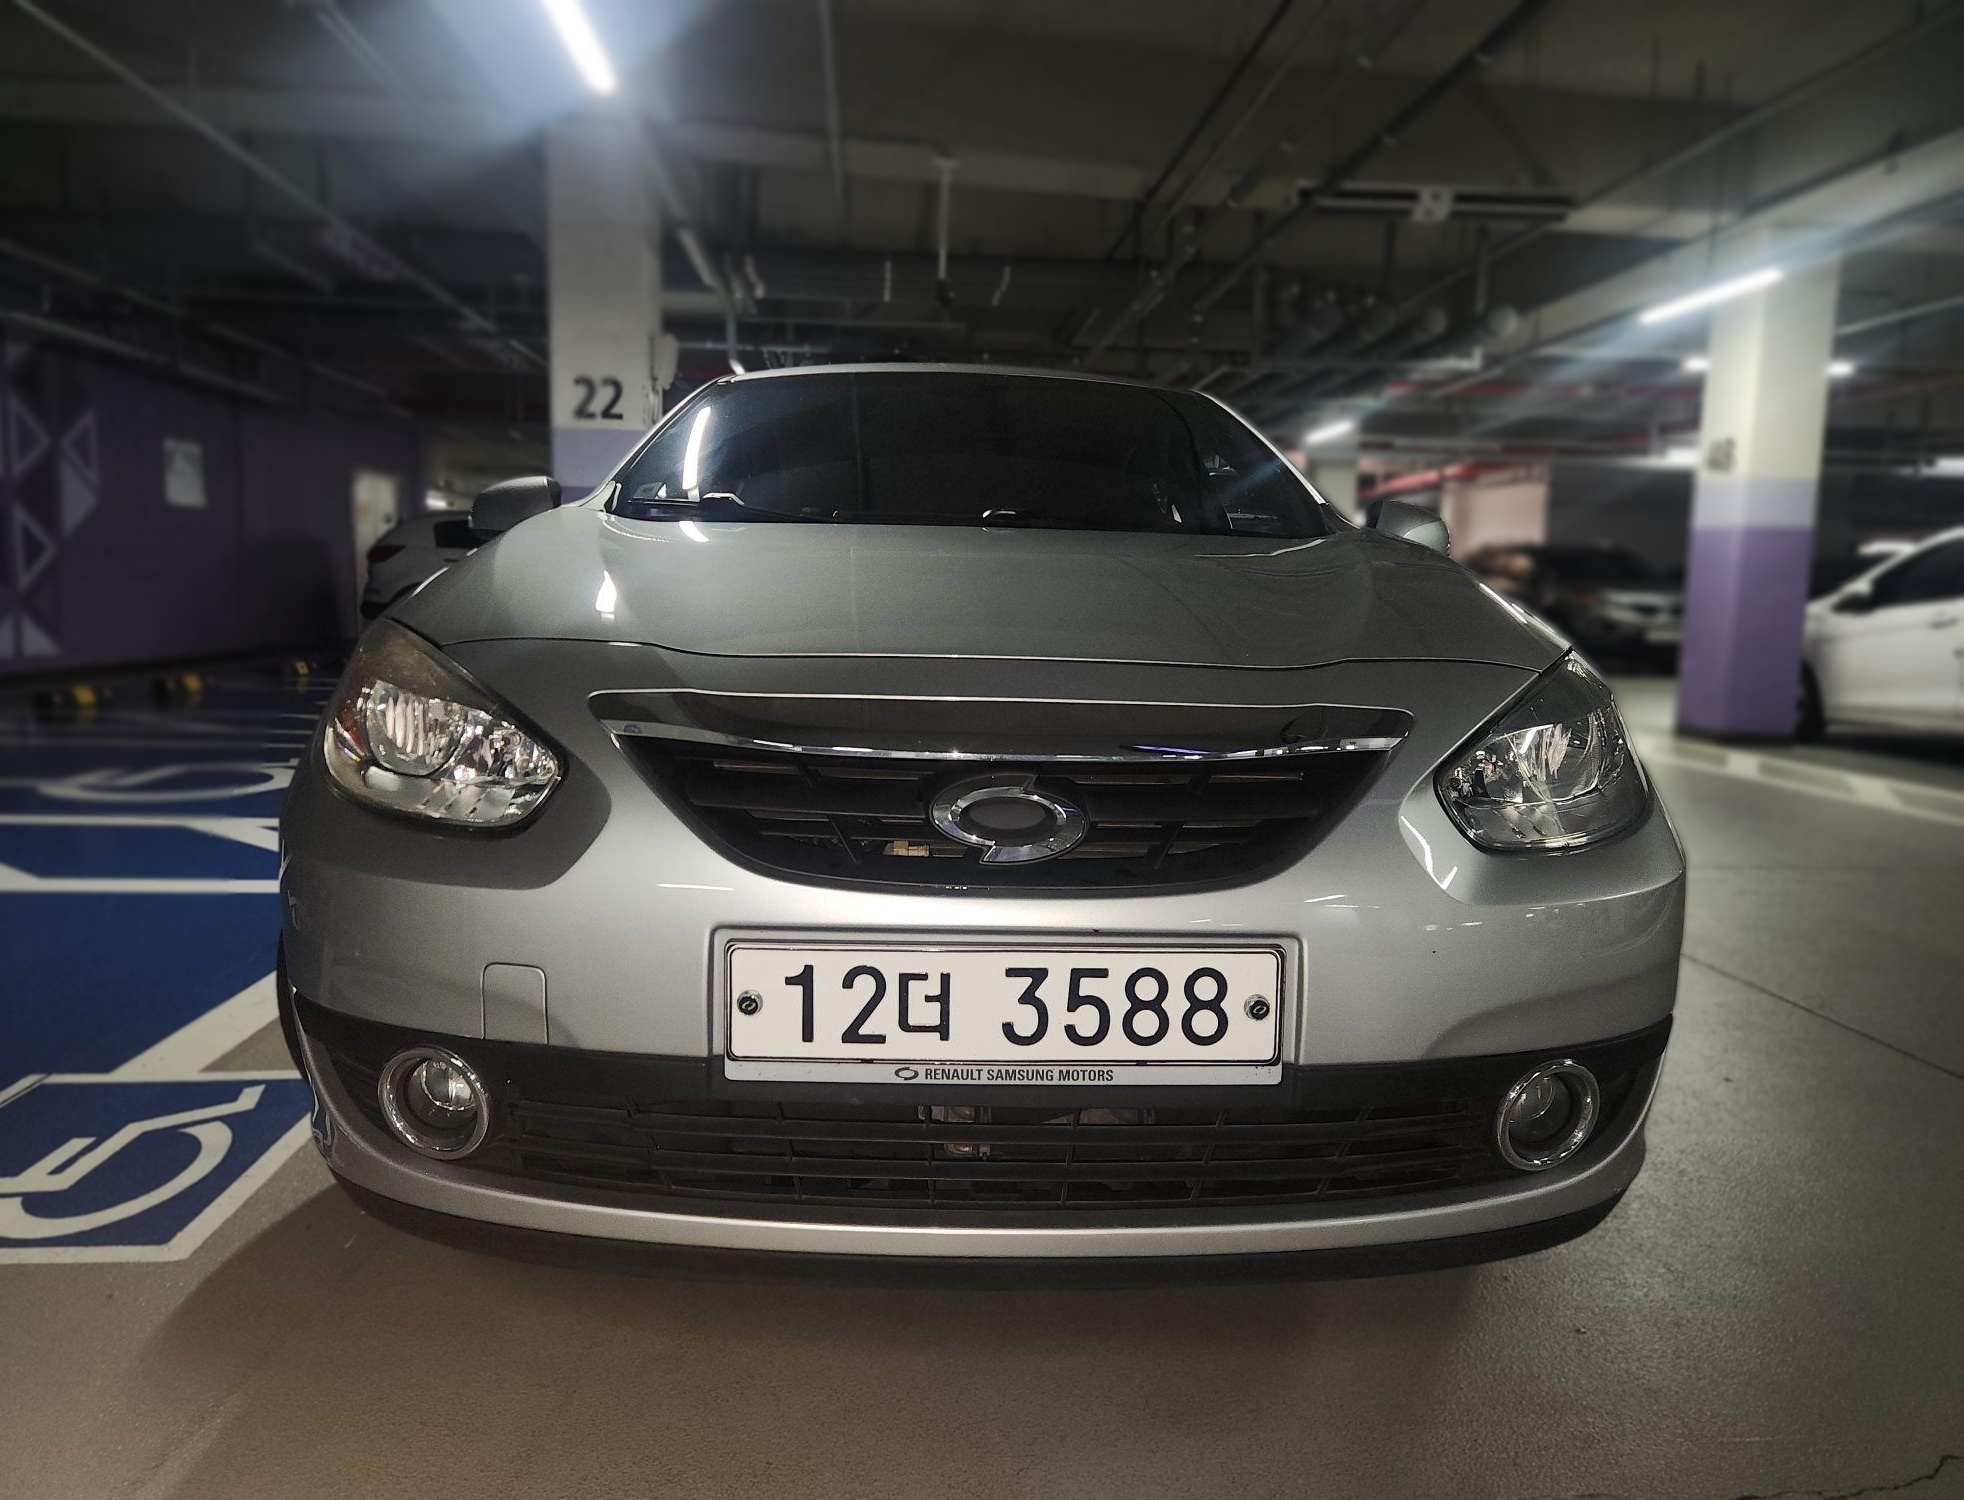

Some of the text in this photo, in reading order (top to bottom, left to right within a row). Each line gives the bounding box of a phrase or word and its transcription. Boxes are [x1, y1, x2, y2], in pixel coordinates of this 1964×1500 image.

[573, 374, 624, 421] 22
[784, 964, 1229, 1047] 12더 3588
[924, 1068, 1114, 1082] RENAULT SAMSUNG MOTORS
